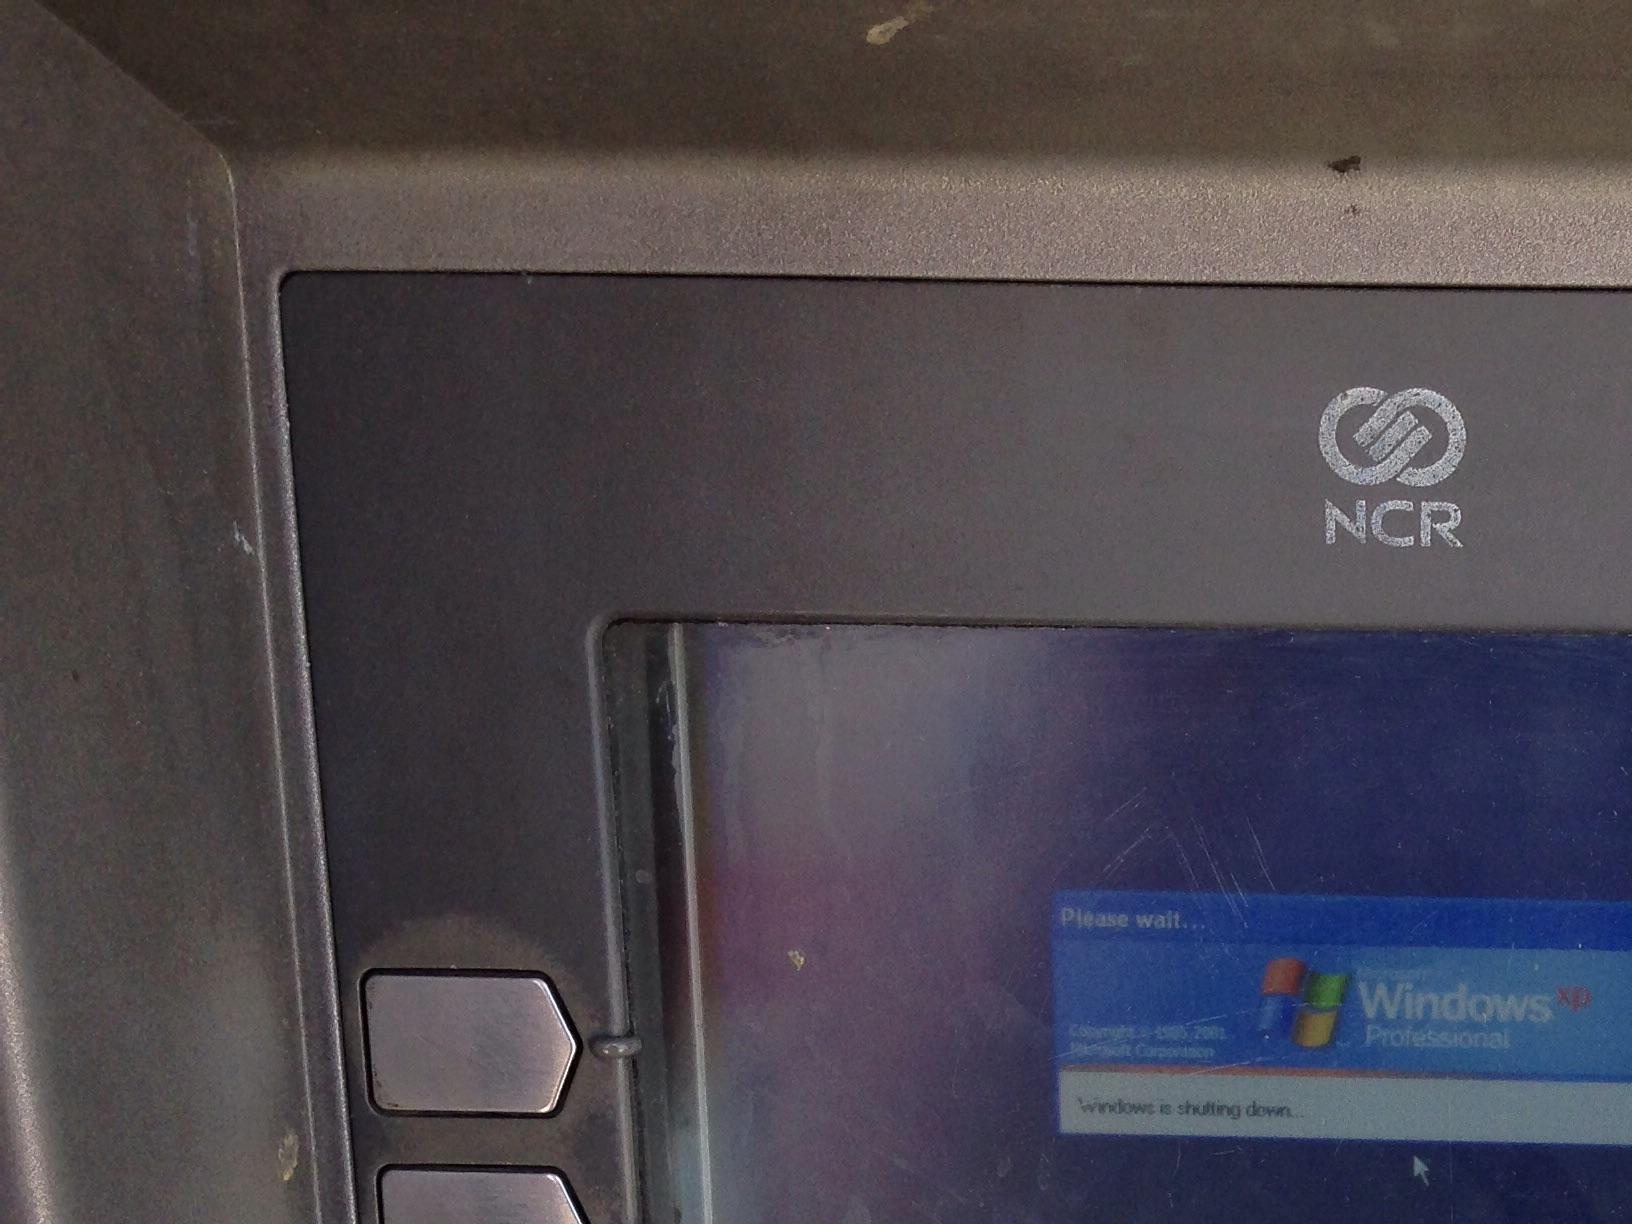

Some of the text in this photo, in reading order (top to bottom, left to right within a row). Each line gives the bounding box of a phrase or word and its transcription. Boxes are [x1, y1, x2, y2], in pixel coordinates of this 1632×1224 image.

[1325, 499, 1464, 548] NCR
[1061, 907, 1129, 929] Please
[1360, 983, 1554, 1023] Windows
[1367, 1025, 1512, 1049] Professional
[1076, 1097, 1155, 1115] Windows
[1159, 1099, 1172, 1116] is
[1177, 1099, 1241, 1120] shutting
